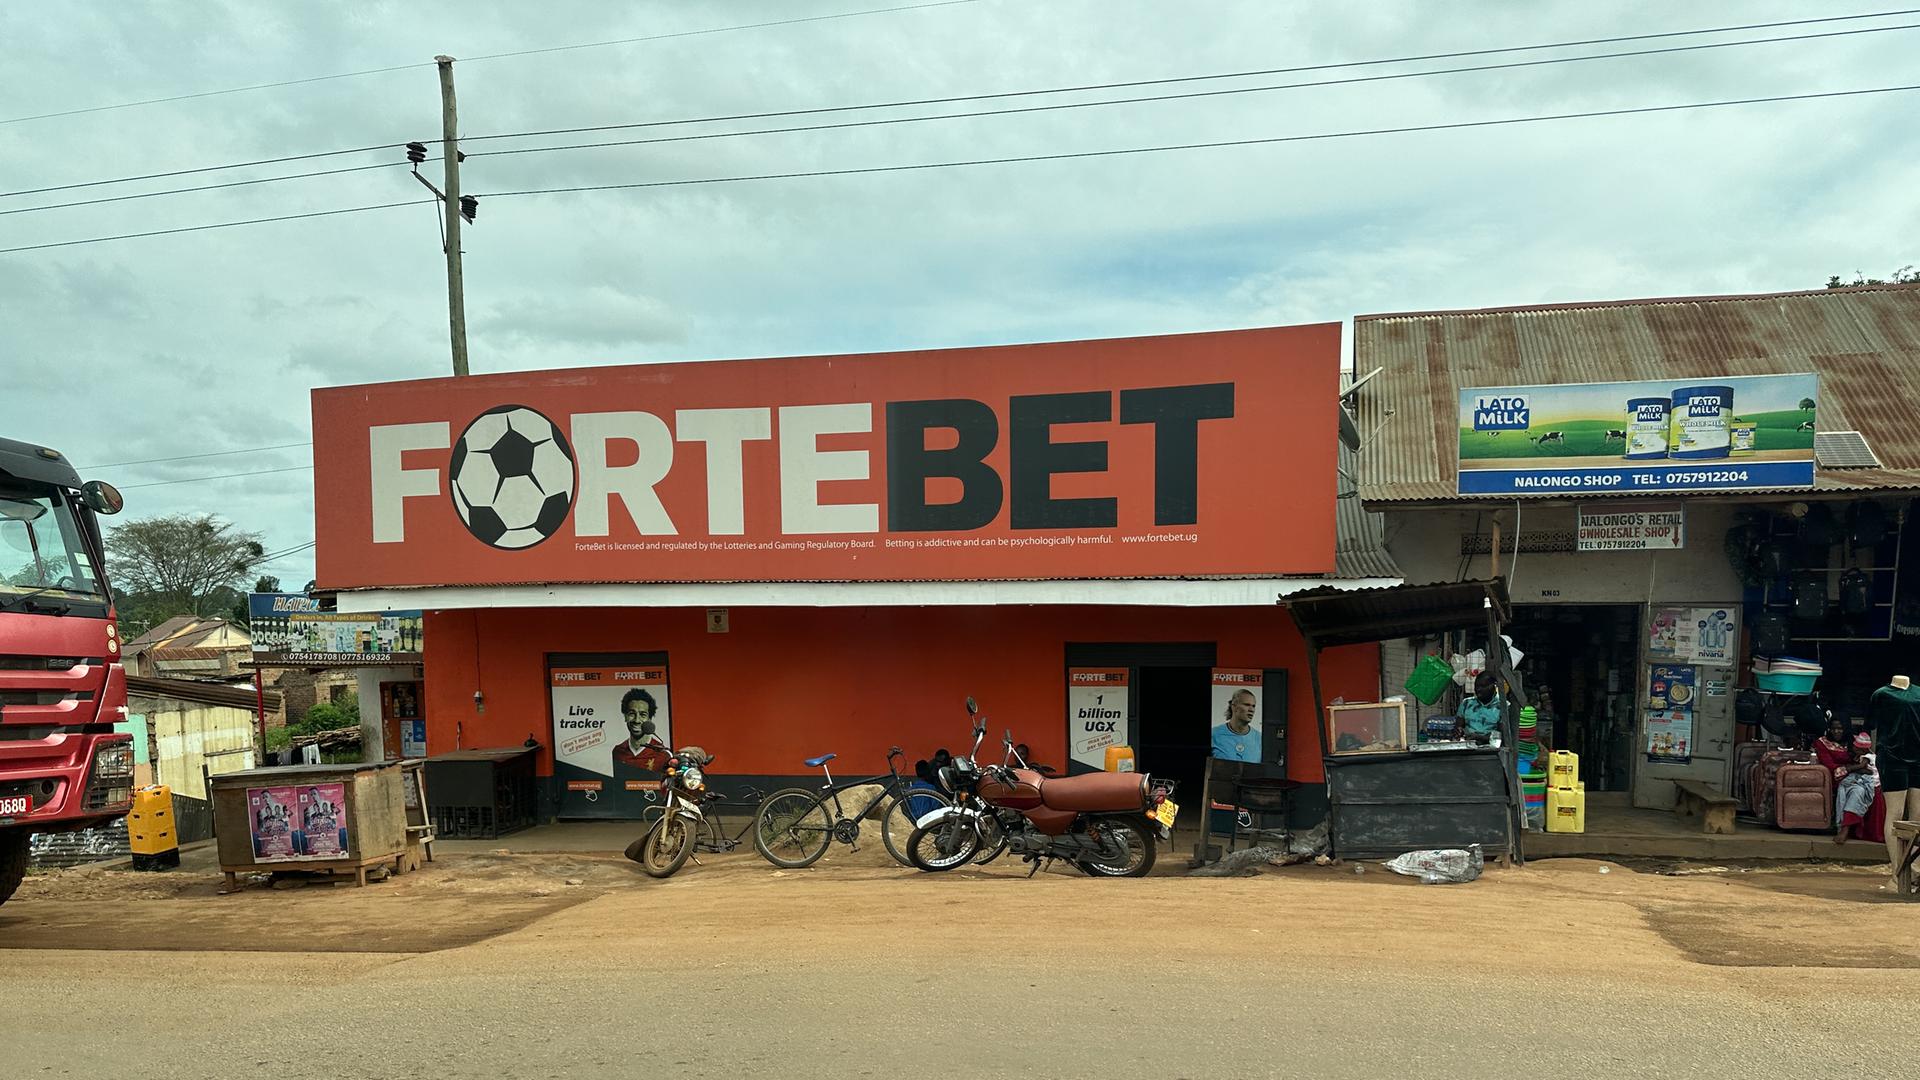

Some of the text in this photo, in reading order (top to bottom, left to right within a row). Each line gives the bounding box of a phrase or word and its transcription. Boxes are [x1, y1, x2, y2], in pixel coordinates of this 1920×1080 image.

[1479, 397, 1525, 410] LATO
[1690, 397, 1719, 406] LATO
[1514, 471, 1748, 487] NALONGO SHOP TEL: 0757912204
[1580, 513, 1683, 527] NALONGO'S RETAIL
[1644, 527, 1671, 538] SHOP
[575, 533, 1198, 551] ForteBet is licensed and regulated by the Lotteries and Gaming Regulatory Board. Betting is addictive and can be psychologically harmful. www.fortebet.ug
[555, 672, 602, 681] FORTEBET
[614, 671, 663, 680] FORTEBET
[1073, 673, 1123, 682] FORTEBET
[1213, 673, 1261, 682] FORTEBET
[1096, 694, 1104, 705] 1
[568, 705, 594, 716] Live
[1078, 708, 1121, 719] billion
[559, 718, 606, 729] tracker
[1085, 721, 1116, 732] UGX
